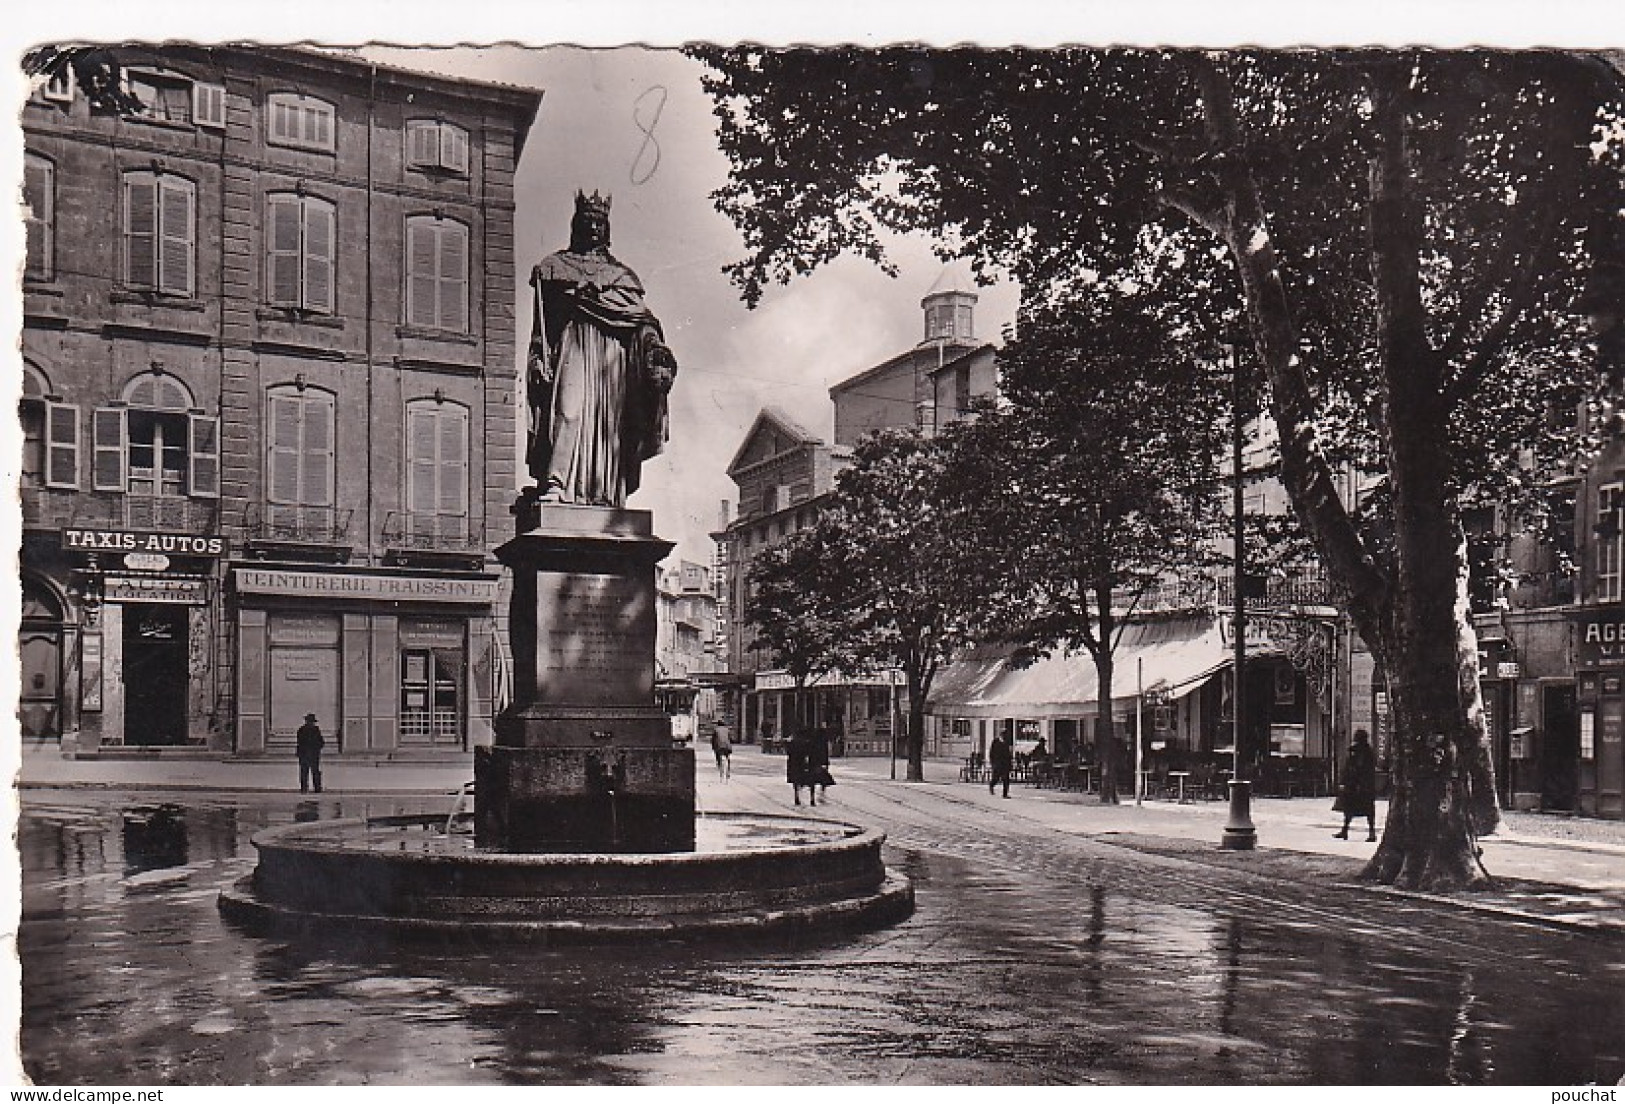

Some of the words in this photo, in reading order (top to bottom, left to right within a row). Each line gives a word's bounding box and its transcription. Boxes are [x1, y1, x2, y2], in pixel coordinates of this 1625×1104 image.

[630, 85, 667, 185] 8
[66, 530, 223, 554] TAXIS-AUTOS
[113, 589, 200, 601] LOCATION
[118, 579, 194, 592] AUTO
[243, 571, 371, 592] TEINTURERIE
[379, 578, 494, 597] FRAISSINET
